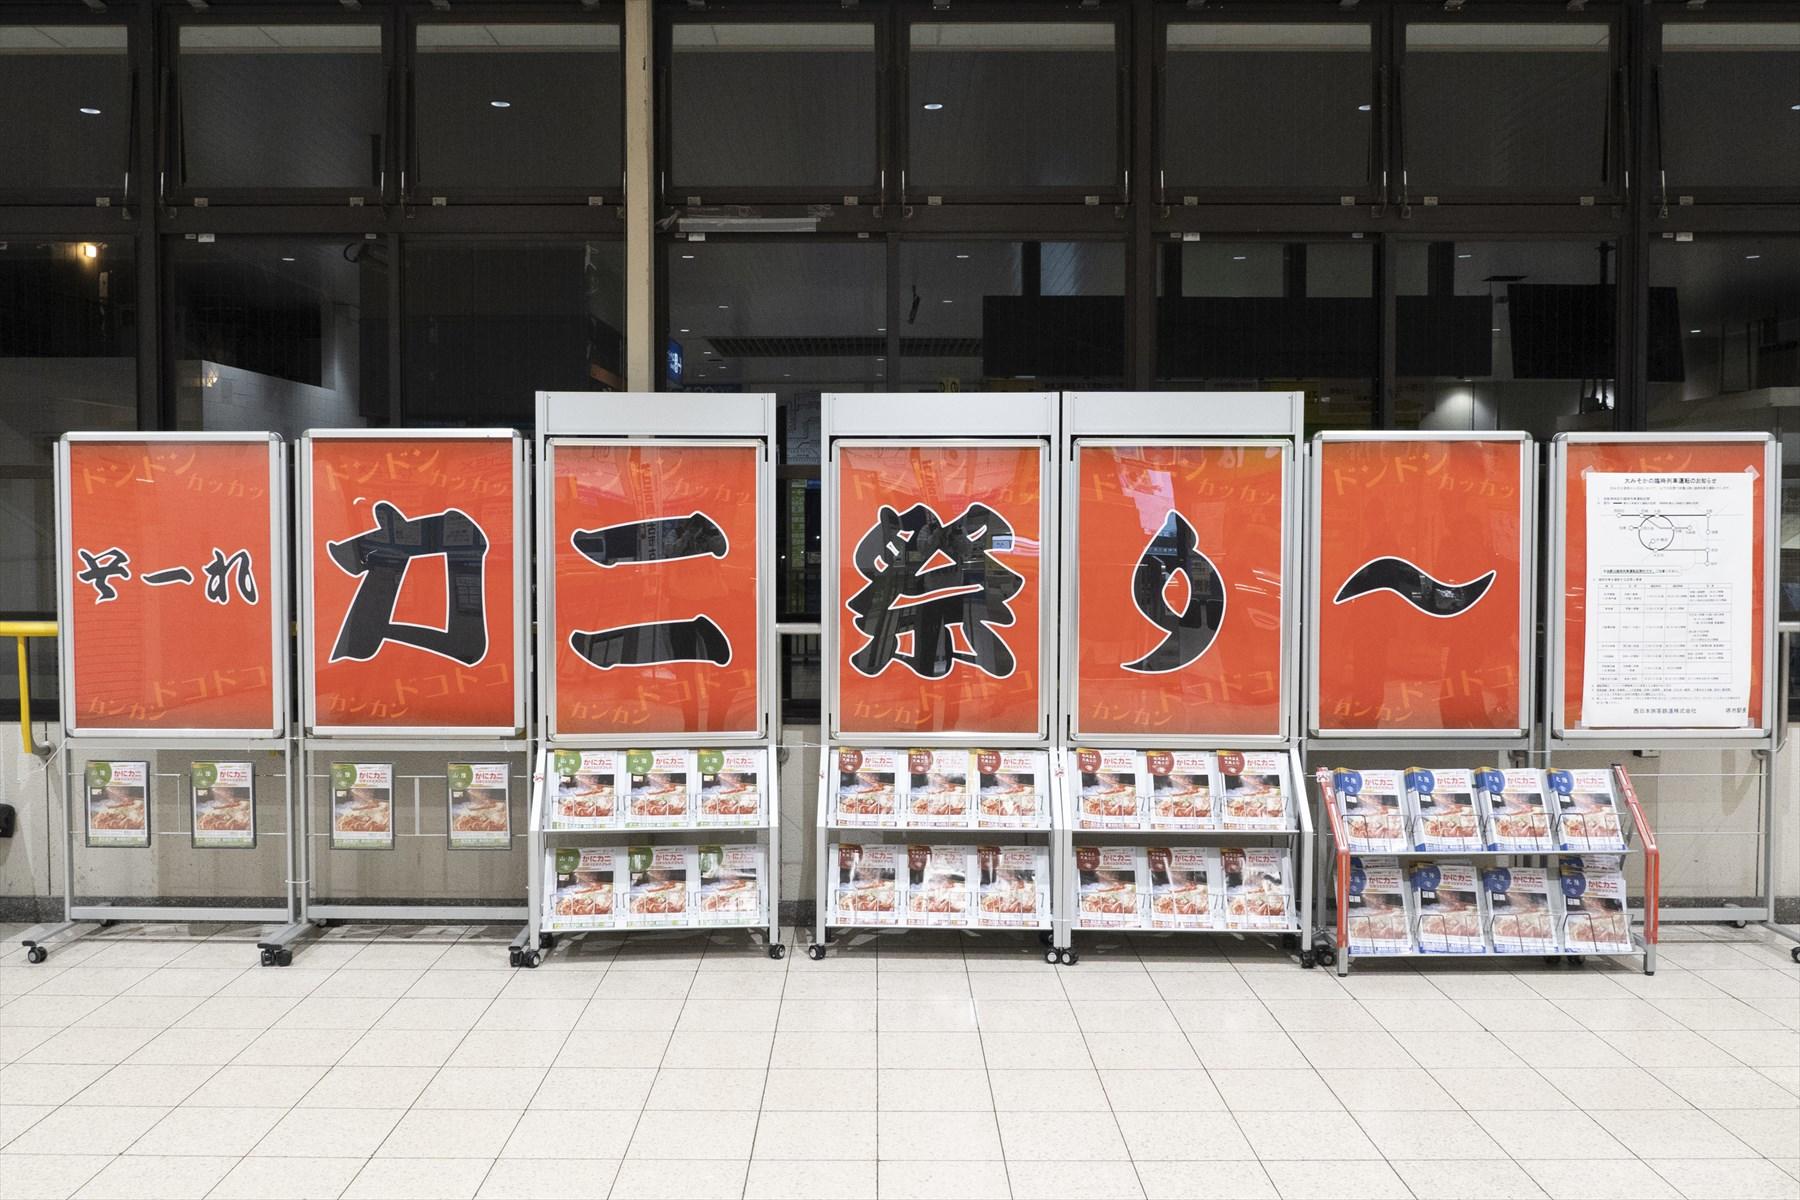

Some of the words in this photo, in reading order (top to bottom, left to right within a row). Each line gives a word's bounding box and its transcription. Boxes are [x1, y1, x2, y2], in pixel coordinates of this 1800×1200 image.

[77, 546, 259, 605] そーれ
[846, 501, 1026, 680] 祭
[1120, 509, 1227, 675] り
[584, 758, 612, 766] かにカニ
[1103, 757, 1132, 765] かにカニ
[1176, 759, 1205, 767] かにカニ
[1247, 759, 1276, 767] かにカニ
[582, 855, 611, 863] かにカニ
[1174, 855, 1203, 863] かにカニ
[1368, 875, 1398, 884] かにカニ
[1442, 875, 1472, 884] かにカニ
[1513, 875, 1543, 884] かにカニ
[1588, 880, 1617, 889] かにカニ
